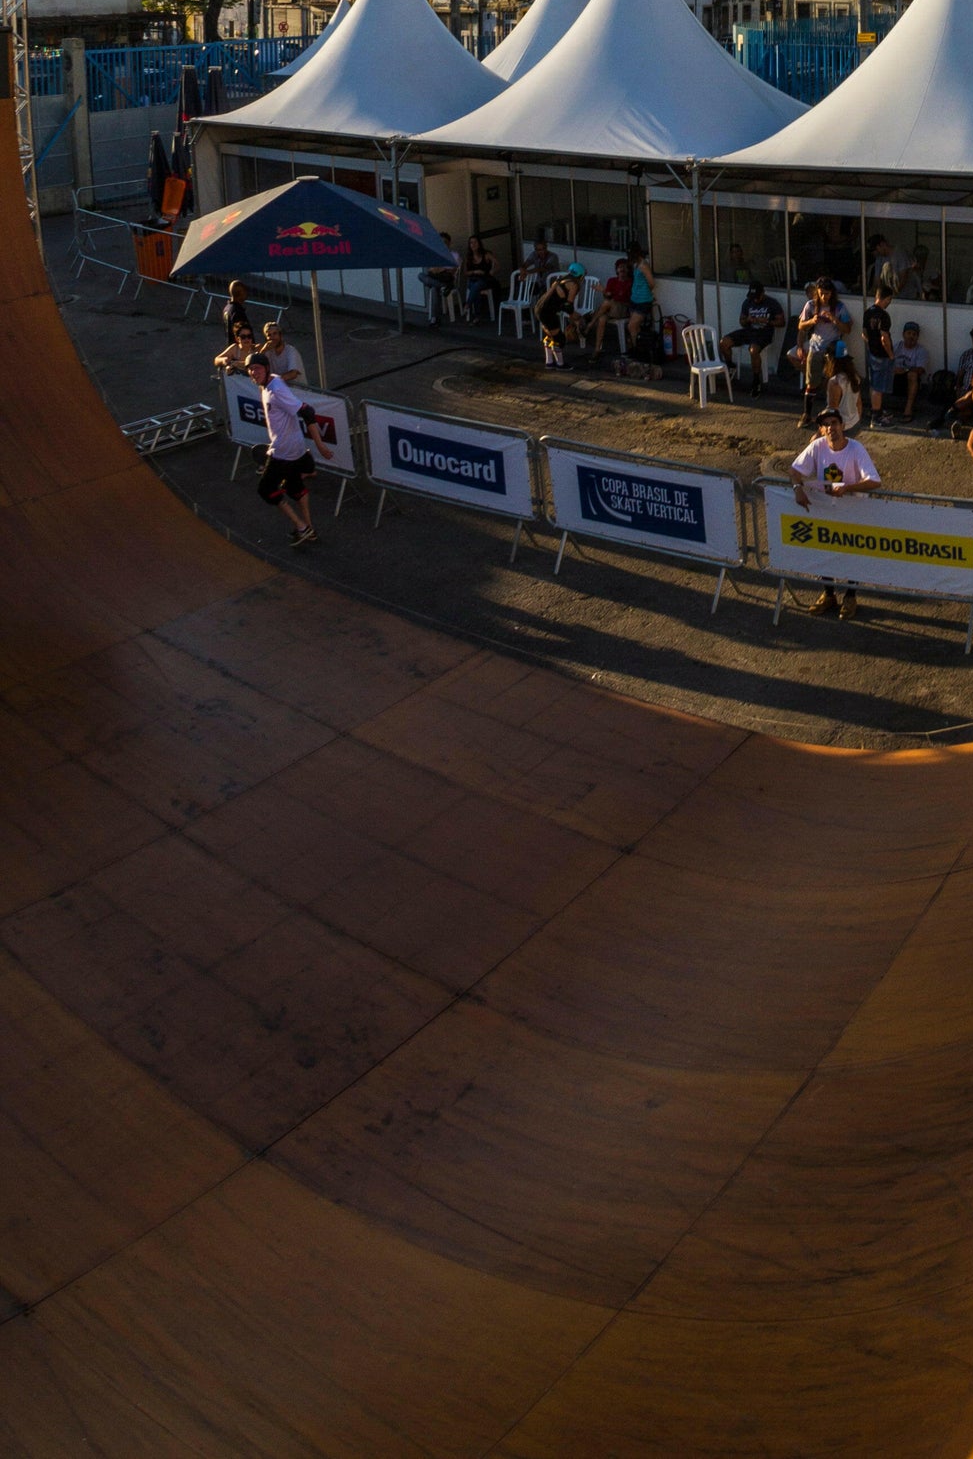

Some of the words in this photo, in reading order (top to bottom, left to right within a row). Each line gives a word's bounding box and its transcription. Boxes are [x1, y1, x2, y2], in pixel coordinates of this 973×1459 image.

[268, 242, 309, 257] Red
[311, 240, 352, 256] Bull
[398, 437, 498, 484] Ourocard
[602, 477, 629, 496] COPA
[631, 483, 672, 503] BRASIL
[674, 490, 690, 507] DE
[610, 495, 644, 515] SKATE
[646, 502, 698, 525] VERTICAL
[817, 526, 877, 551] BANCO
[879, 536, 903, 554] DO
[905, 538, 967, 562] BRASIL
